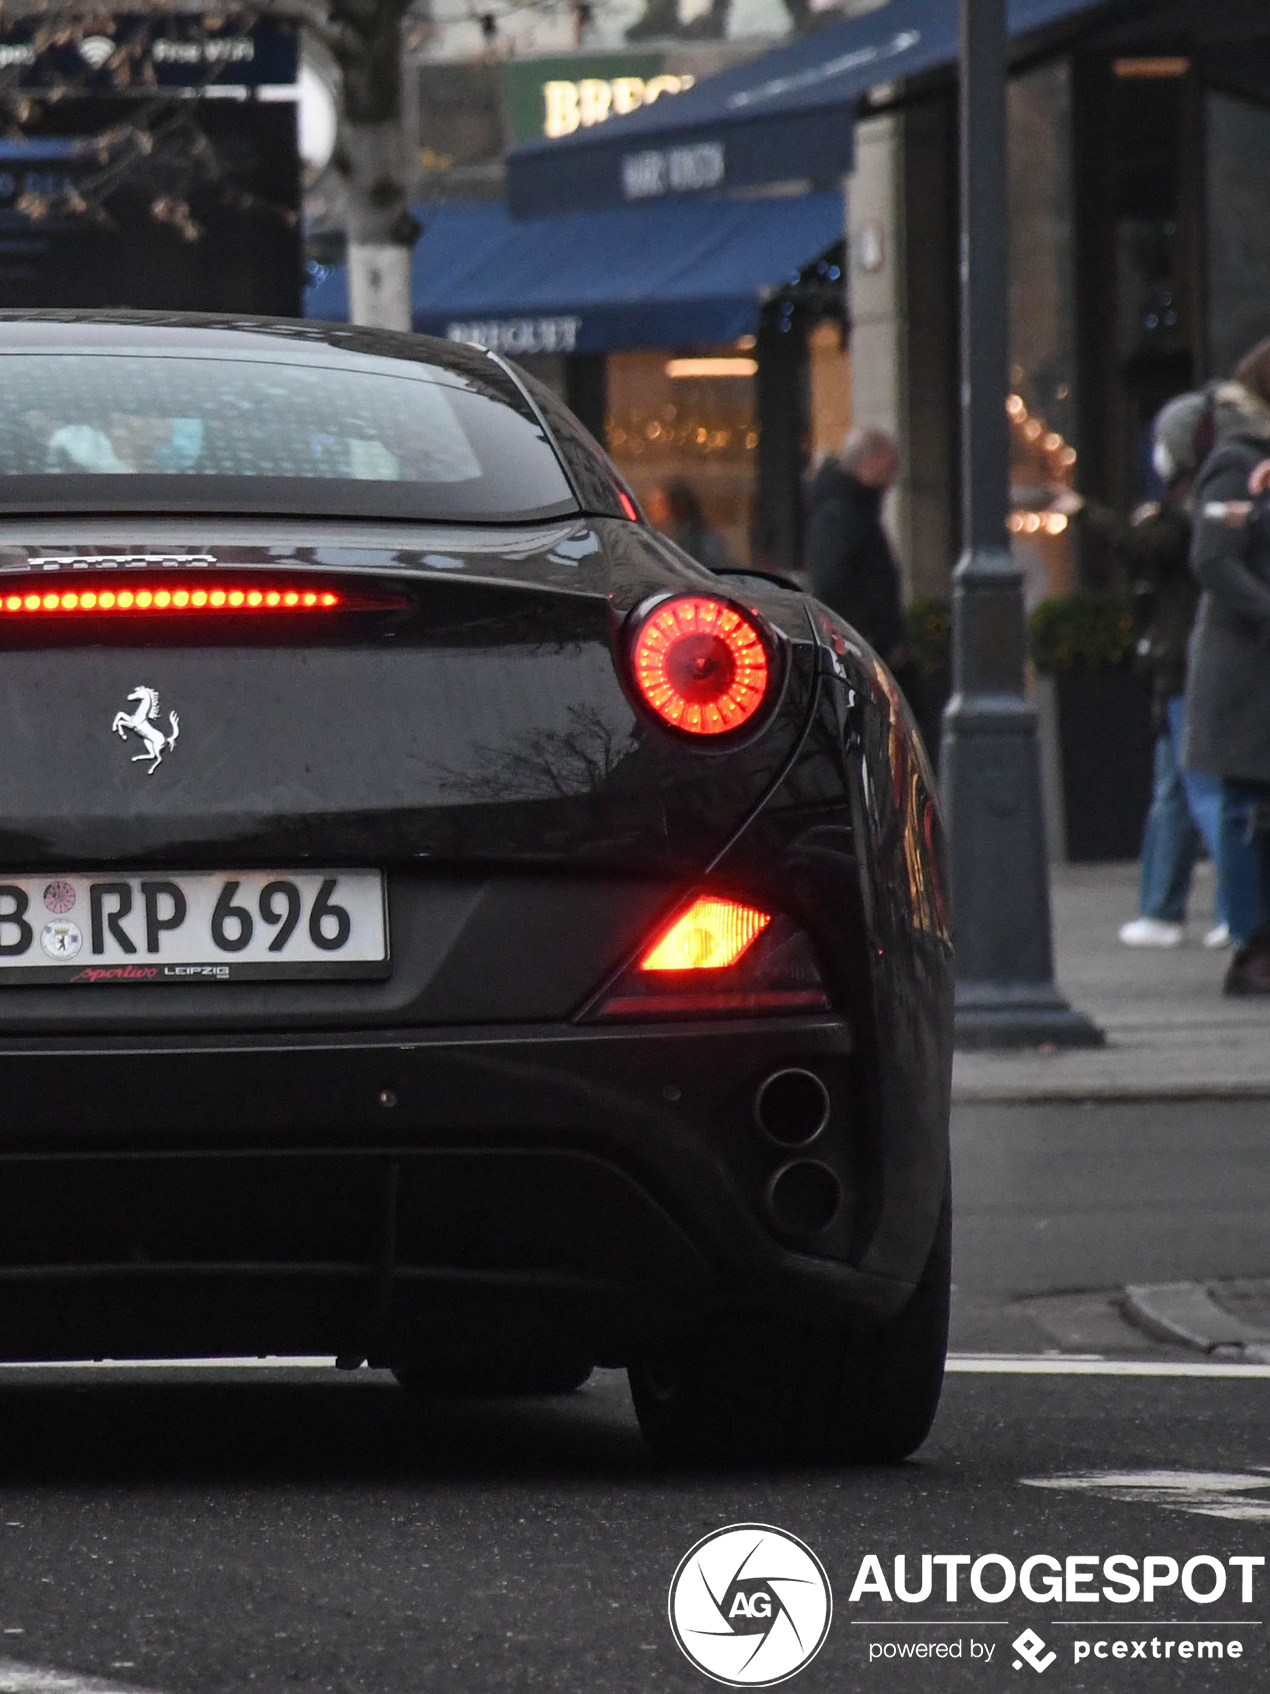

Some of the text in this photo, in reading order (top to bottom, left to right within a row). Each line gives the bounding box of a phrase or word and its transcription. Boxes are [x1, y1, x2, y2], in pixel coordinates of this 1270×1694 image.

[90, 882, 187, 953] RP
[211, 879, 352, 952] 696
[164, 966, 229, 976] LEIPZIG
